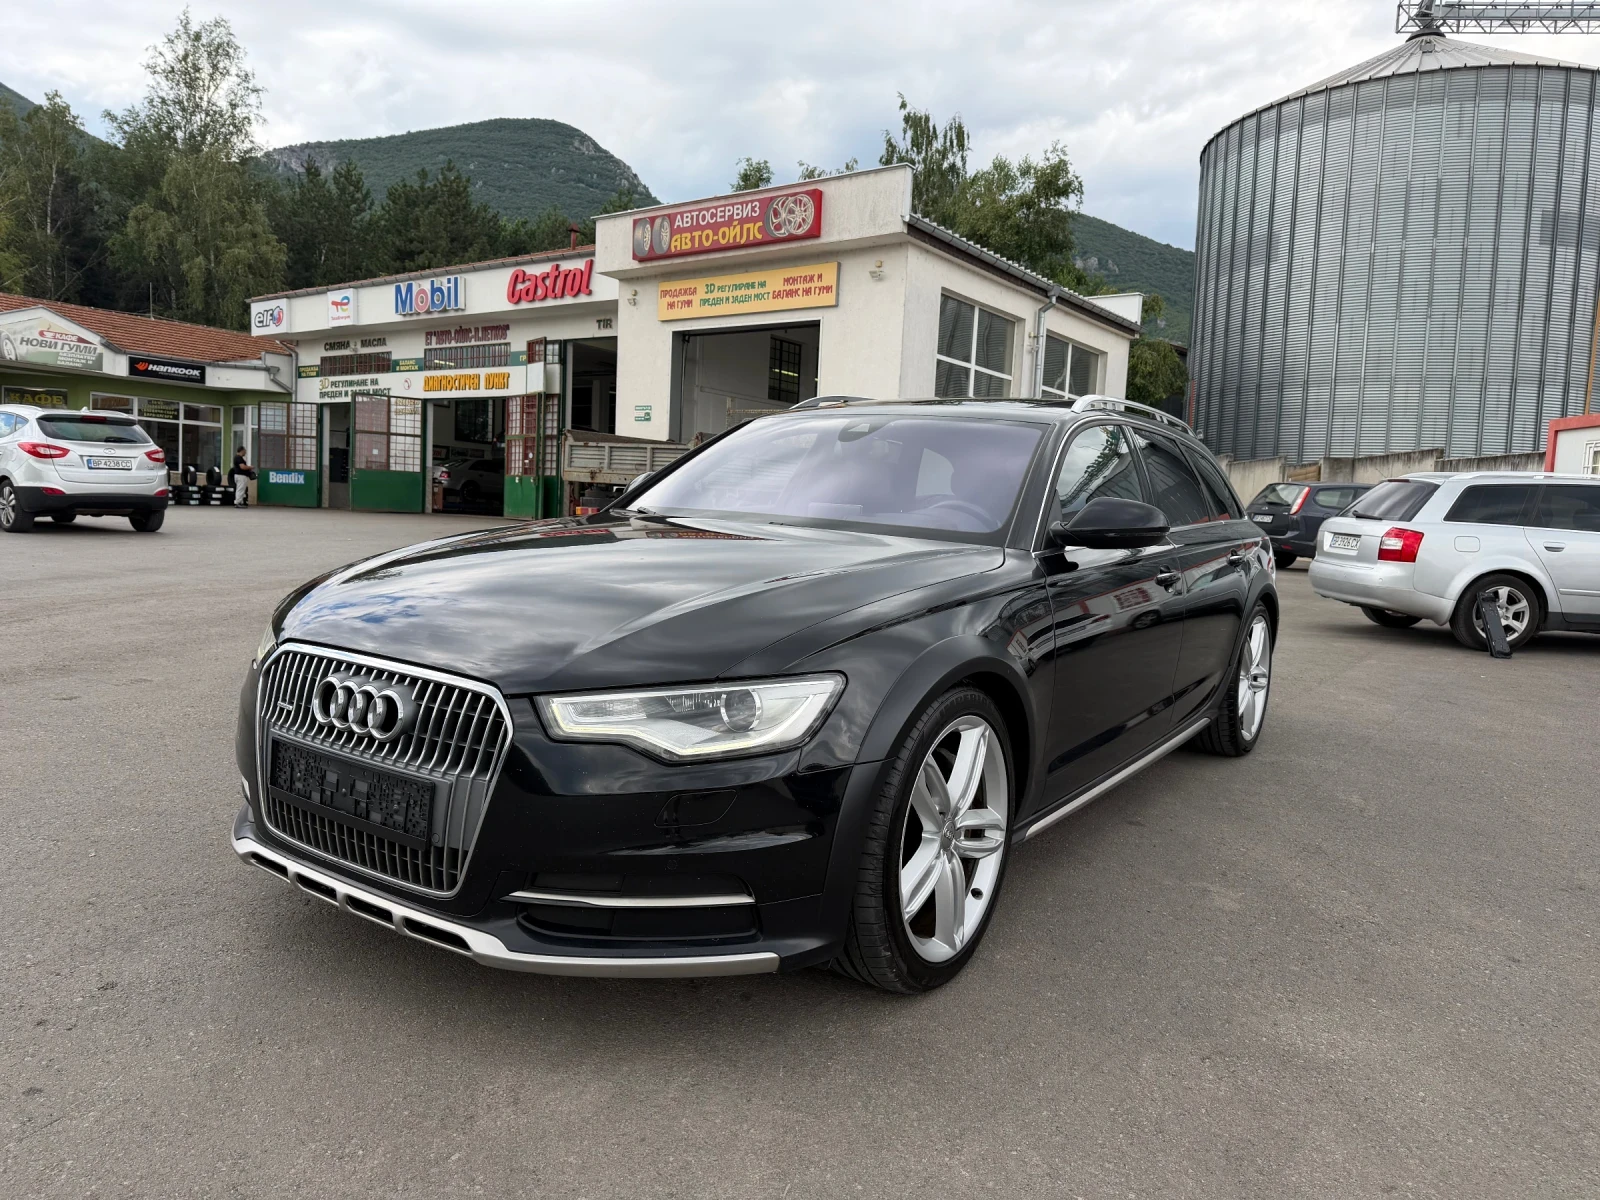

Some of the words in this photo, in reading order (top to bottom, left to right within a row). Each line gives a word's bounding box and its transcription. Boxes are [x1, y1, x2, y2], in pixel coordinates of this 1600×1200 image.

[674, 202, 760, 228] АВТОСЕРВИЗ
[670, 221, 763, 252] АВТО-ОЙЛС
[507, 258, 593, 304] Castrol
[705, 283, 716, 294] 3D
[717, 282, 756, 293] РЕГУЛИРАНЕ
[757, 280, 766, 290] НА
[783, 273, 815, 287] МОНТАЖ
[817, 273, 823, 283] И
[394, 276, 460, 315] Mobil
[660, 287, 697, 299] ПРОДАЖБА
[700, 296, 724, 307] ПРЕДЕН
[731, 293, 752, 304] ЗАДЕН
[753, 292, 770, 301] МОСТ
[772, 287, 800, 300] БАЛАНС
[802, 286, 812, 297] НА
[813, 285, 833, 296] ГУМИ
[667, 300, 676, 310] НА
[677, 299, 693, 309] ГУМИ
[254, 307, 273, 328] elf
[596, 318, 613, 330] TIR
[20, 336, 57, 350] НОВИ
[60, 342, 98, 356] ГУМИ
[324, 340, 350, 352] СМЯНА
[361, 337, 387, 348] МАСЛА
[330, 379, 369, 389] РЕГУЛИРАНЕ
[370, 378, 379, 386] НА
[423, 373, 480, 392] ДИАГНОСТИЧЕН
[484, 372, 510, 390] ПУНКТ
[9, 392, 63, 405] КАФЕ
[319, 389, 343, 400] ПРЕДЕН
[344, 389, 349, 397] И
[104, 459, 120, 468] 4238
[269, 471, 305, 484] Bendix
